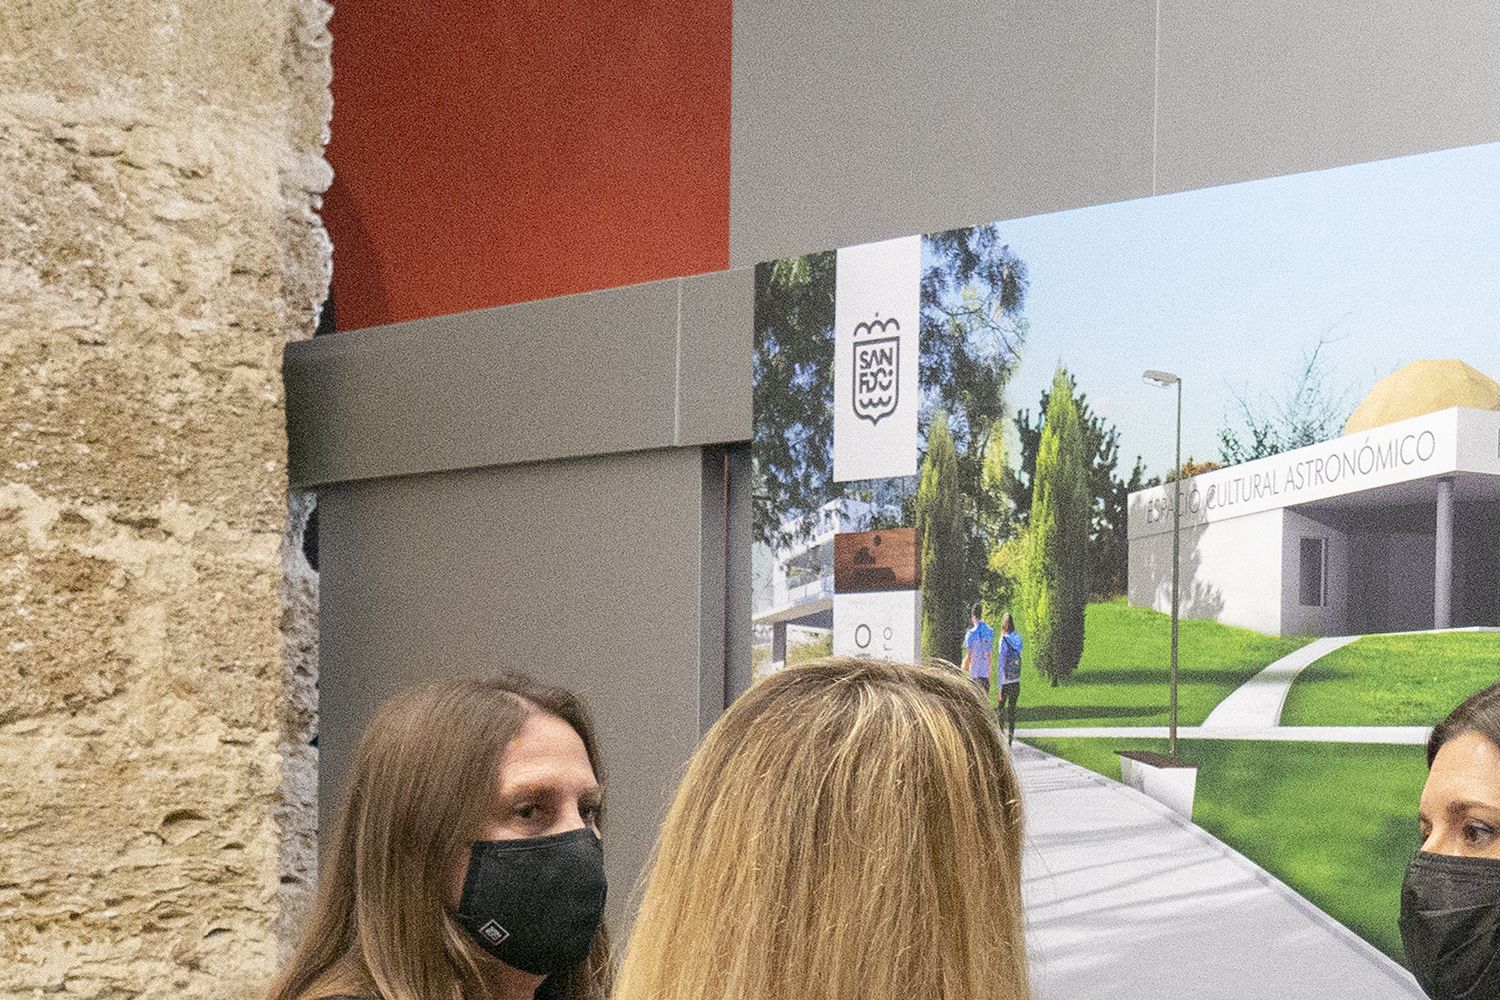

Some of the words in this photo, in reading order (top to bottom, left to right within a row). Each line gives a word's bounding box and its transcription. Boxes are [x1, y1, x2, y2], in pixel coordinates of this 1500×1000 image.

[860, 348, 893, 370] SAN
[1206, 466, 1279, 509] CULTURAL
[1284, 429, 1435, 492] ASTRONÓMICO
